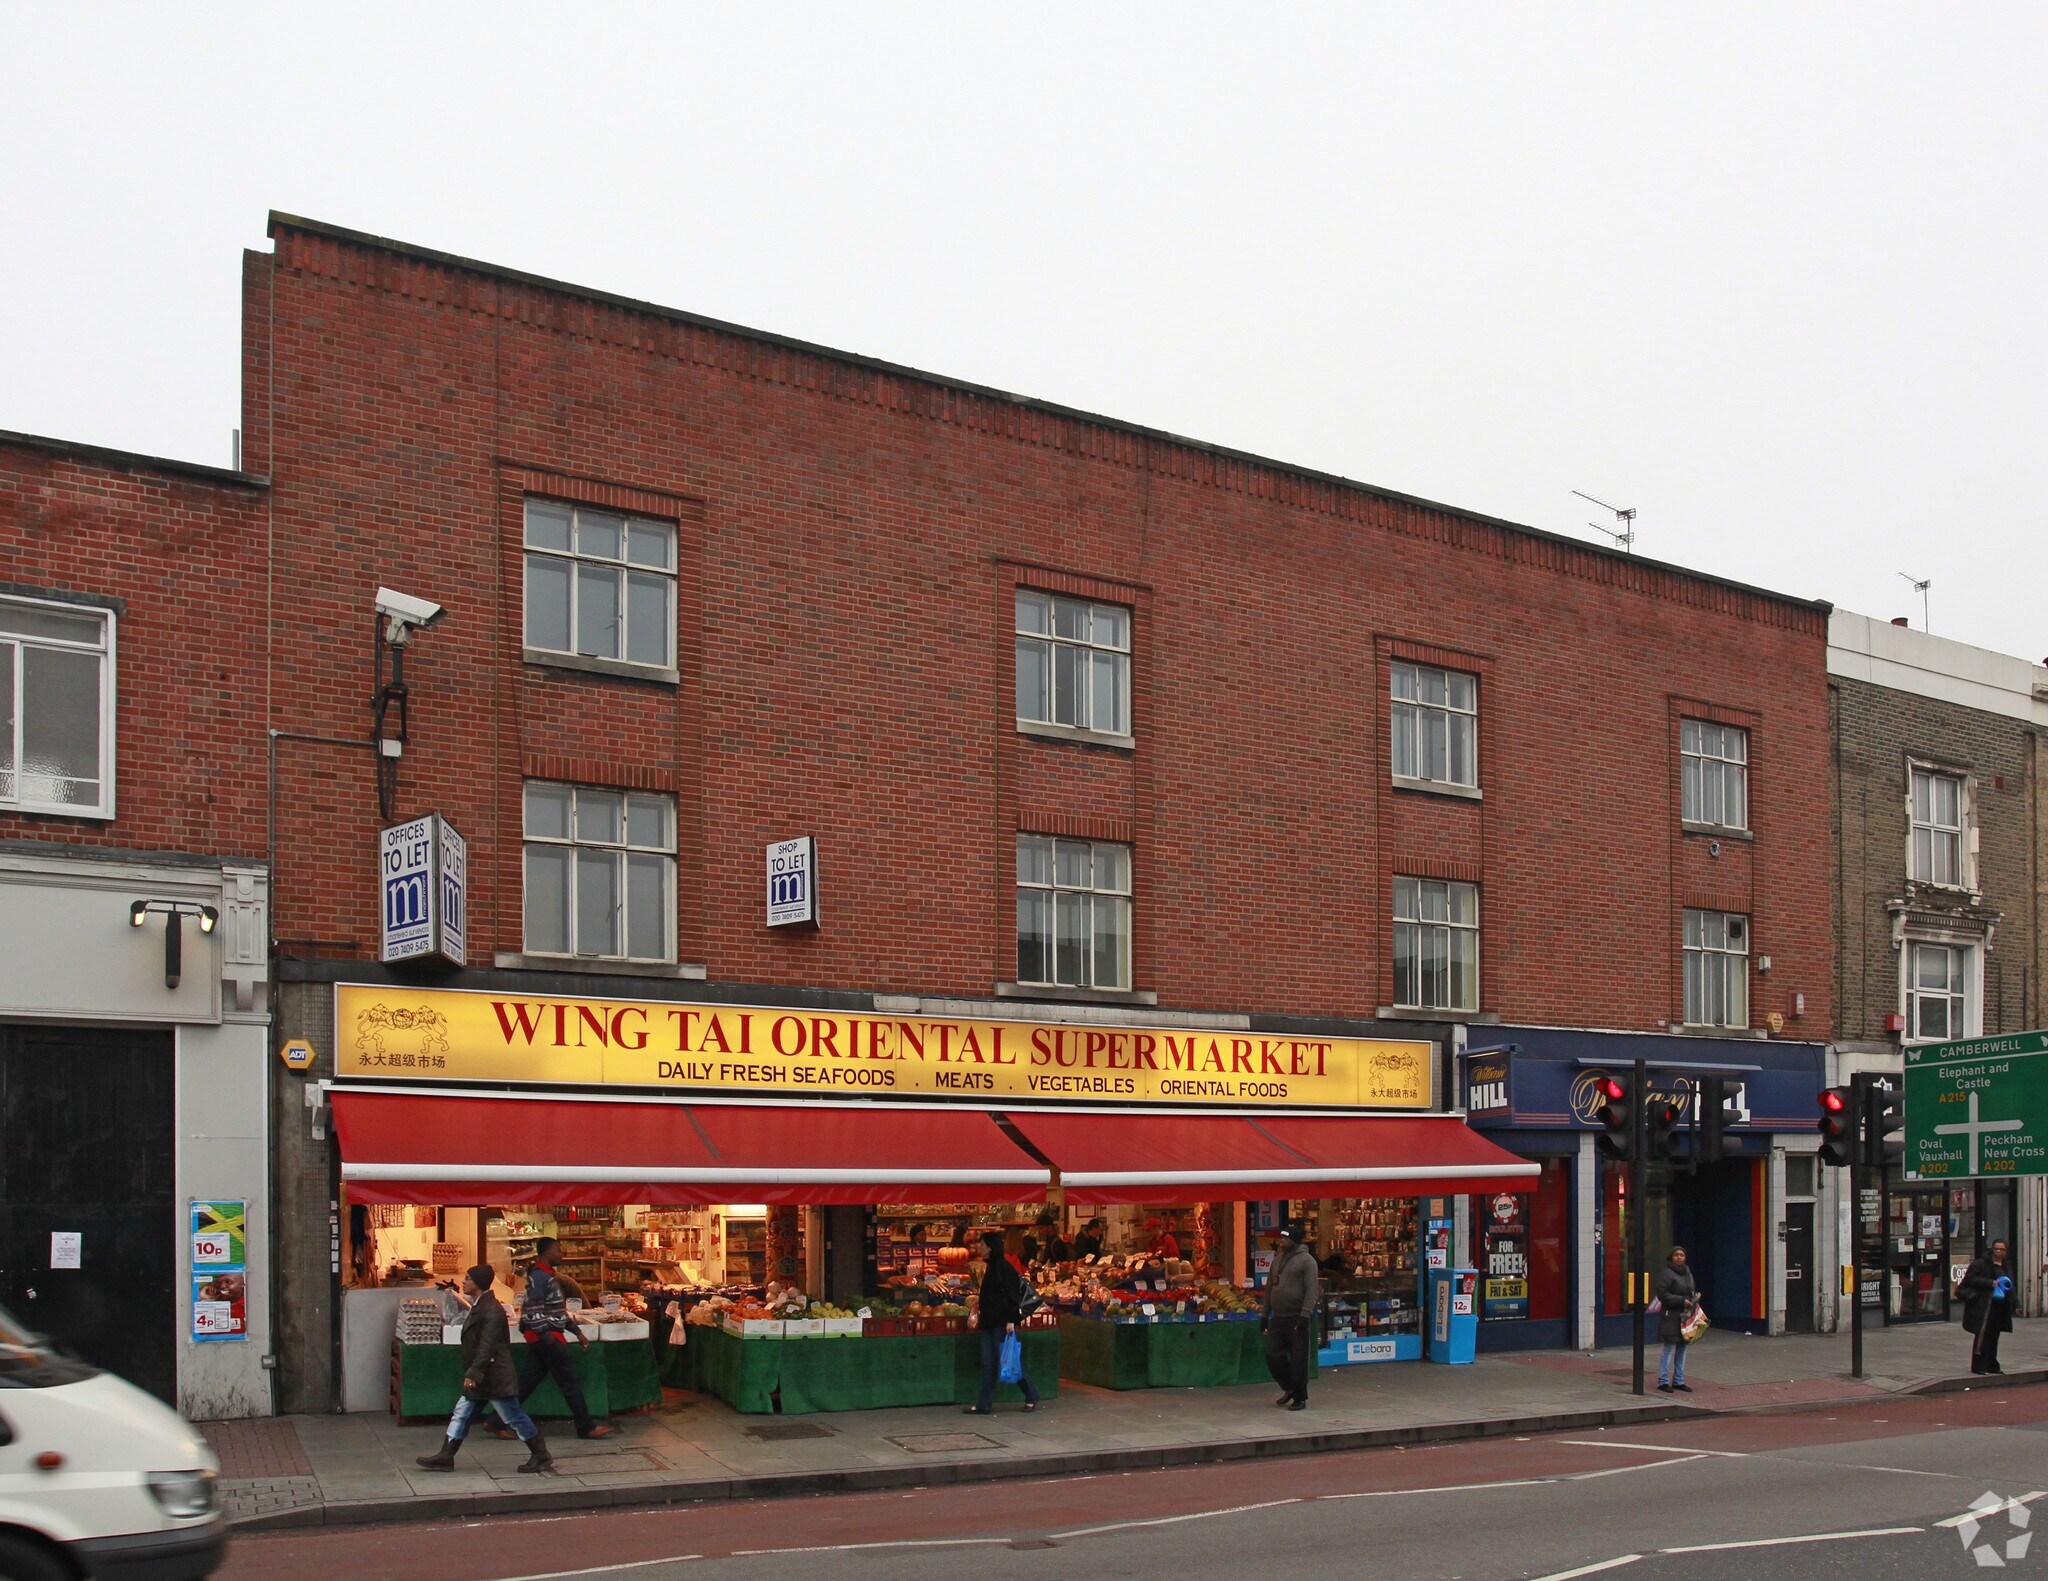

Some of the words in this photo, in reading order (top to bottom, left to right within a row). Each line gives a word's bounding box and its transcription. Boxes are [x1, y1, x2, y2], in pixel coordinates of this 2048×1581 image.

[388, 823, 424, 846] OFFICES
[778, 842, 798, 854] SHOP
[384, 848, 402, 875] TO
[407, 840, 429, 868] LET
[442, 843, 452, 871] TO
[771, 857, 785, 872] TO
[789, 854, 805, 869] LET
[388, 946, 400, 957] 020
[490, 1002, 650, 1050] WING
[668, 1011, 755, 1055] TAI
[771, 1016, 1016, 1065] ORIENTAL
[1031, 1028, 1332, 1077] SUPERMARKET
[290, 1051, 306, 1059] ADT
[1939, 1040, 2021, 1058] CAMBERWELL
[359, 1053, 445, 1069] 永大超级市场
[1939, 1065, 1985, 1079] Elephant
[1989, 1062, 2009, 1073] and
[658, 1061, 714, 1080] DAILY
[720, 1064, 786, 1082] FRESH
[793, 1067, 895, 1086] SEAFOODS
[935, 1072, 994, 1089] MEATS
[1028, 1075, 1134, 1093] VEGETABLES
[1160, 1080, 1235, 1096] ORIENTAL
[1239, 1083, 1288, 1097] FOODS
[1956, 1078, 1991, 1089] Castle
[1370, 1088, 1418, 1099] 永大超级市场
[1470, 1082, 1507, 1110] HILL
[1920, 1138, 1943, 1149] Oval
[1984, 1134, 2033, 1145] Peckham
[1920, 1150, 1963, 1161] Vauxhall
[1984, 1148, 2008, 1158] New
[2013, 1146, 2045, 1157] Cross
[196, 1242, 222, 1255] 10p
[1499, 1241, 1513, 1252] FOR
[1256, 1258, 1270, 1267] 15p
[1429, 1256, 1442, 1265] 12p
[1489, 1254, 1523, 1274] FREE!
[1490, 1286, 1501, 1297] FRI
[1502, 1287, 1508, 1296] &
[1509, 1285, 1522, 1296] SAT
[1437, 1286, 1445, 1325] Lebara
[1454, 1301, 1467, 1311] 12p
[197, 1315, 214, 1327] 4p
[1360, 1344, 1391, 1353] Lebara
